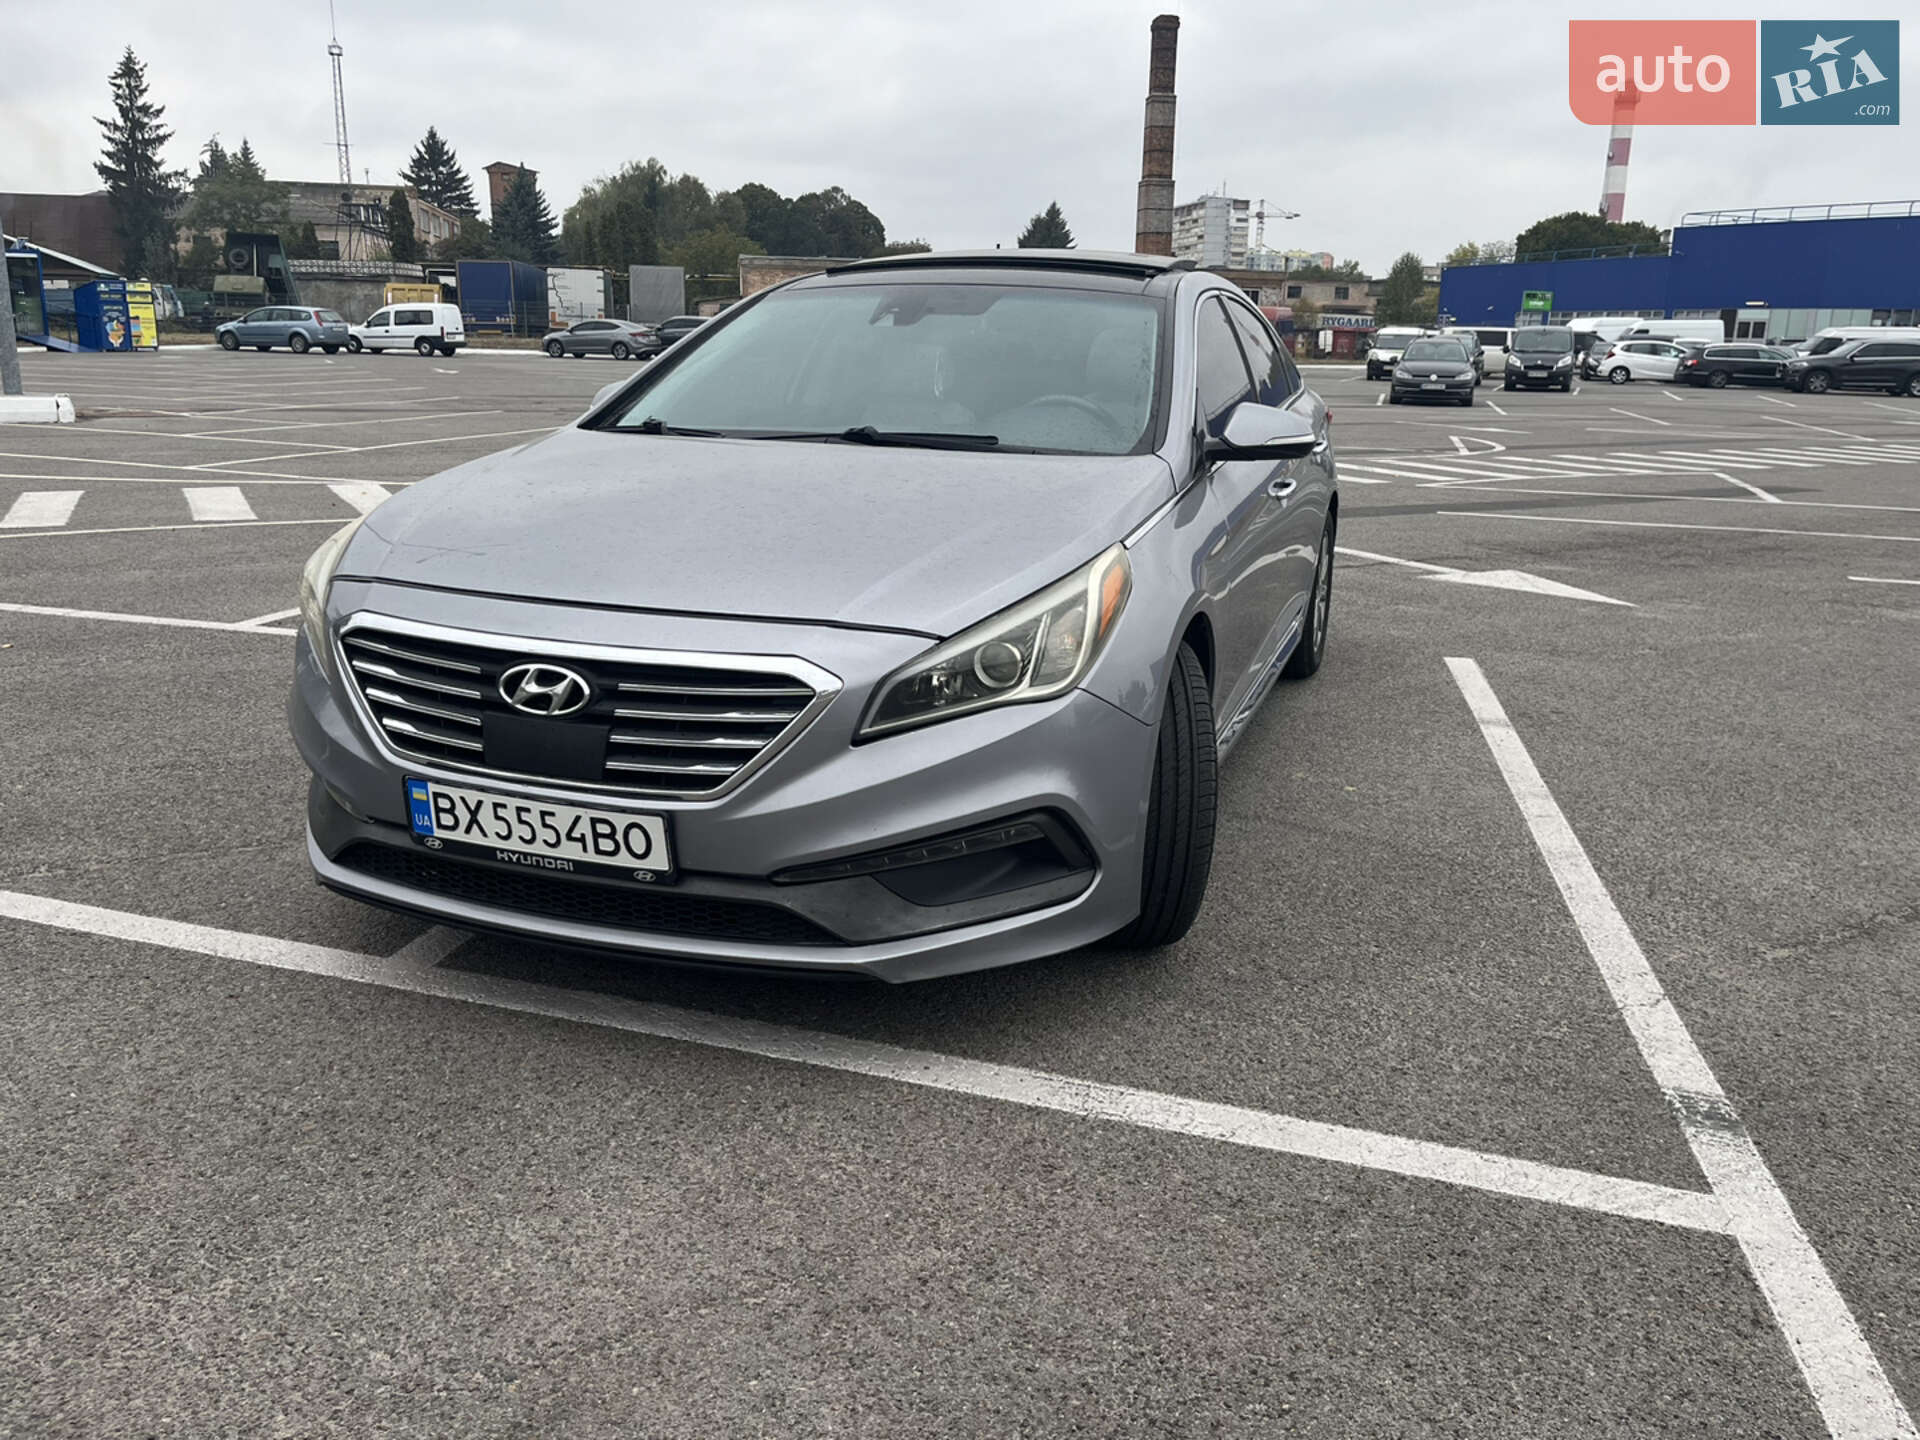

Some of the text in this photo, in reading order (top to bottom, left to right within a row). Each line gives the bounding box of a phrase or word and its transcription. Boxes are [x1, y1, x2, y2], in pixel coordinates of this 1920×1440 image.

[415, 813, 432, 828] UA
[432, 791, 653, 861] BX5554BO
[496, 850, 575, 872] HYUNDAI
